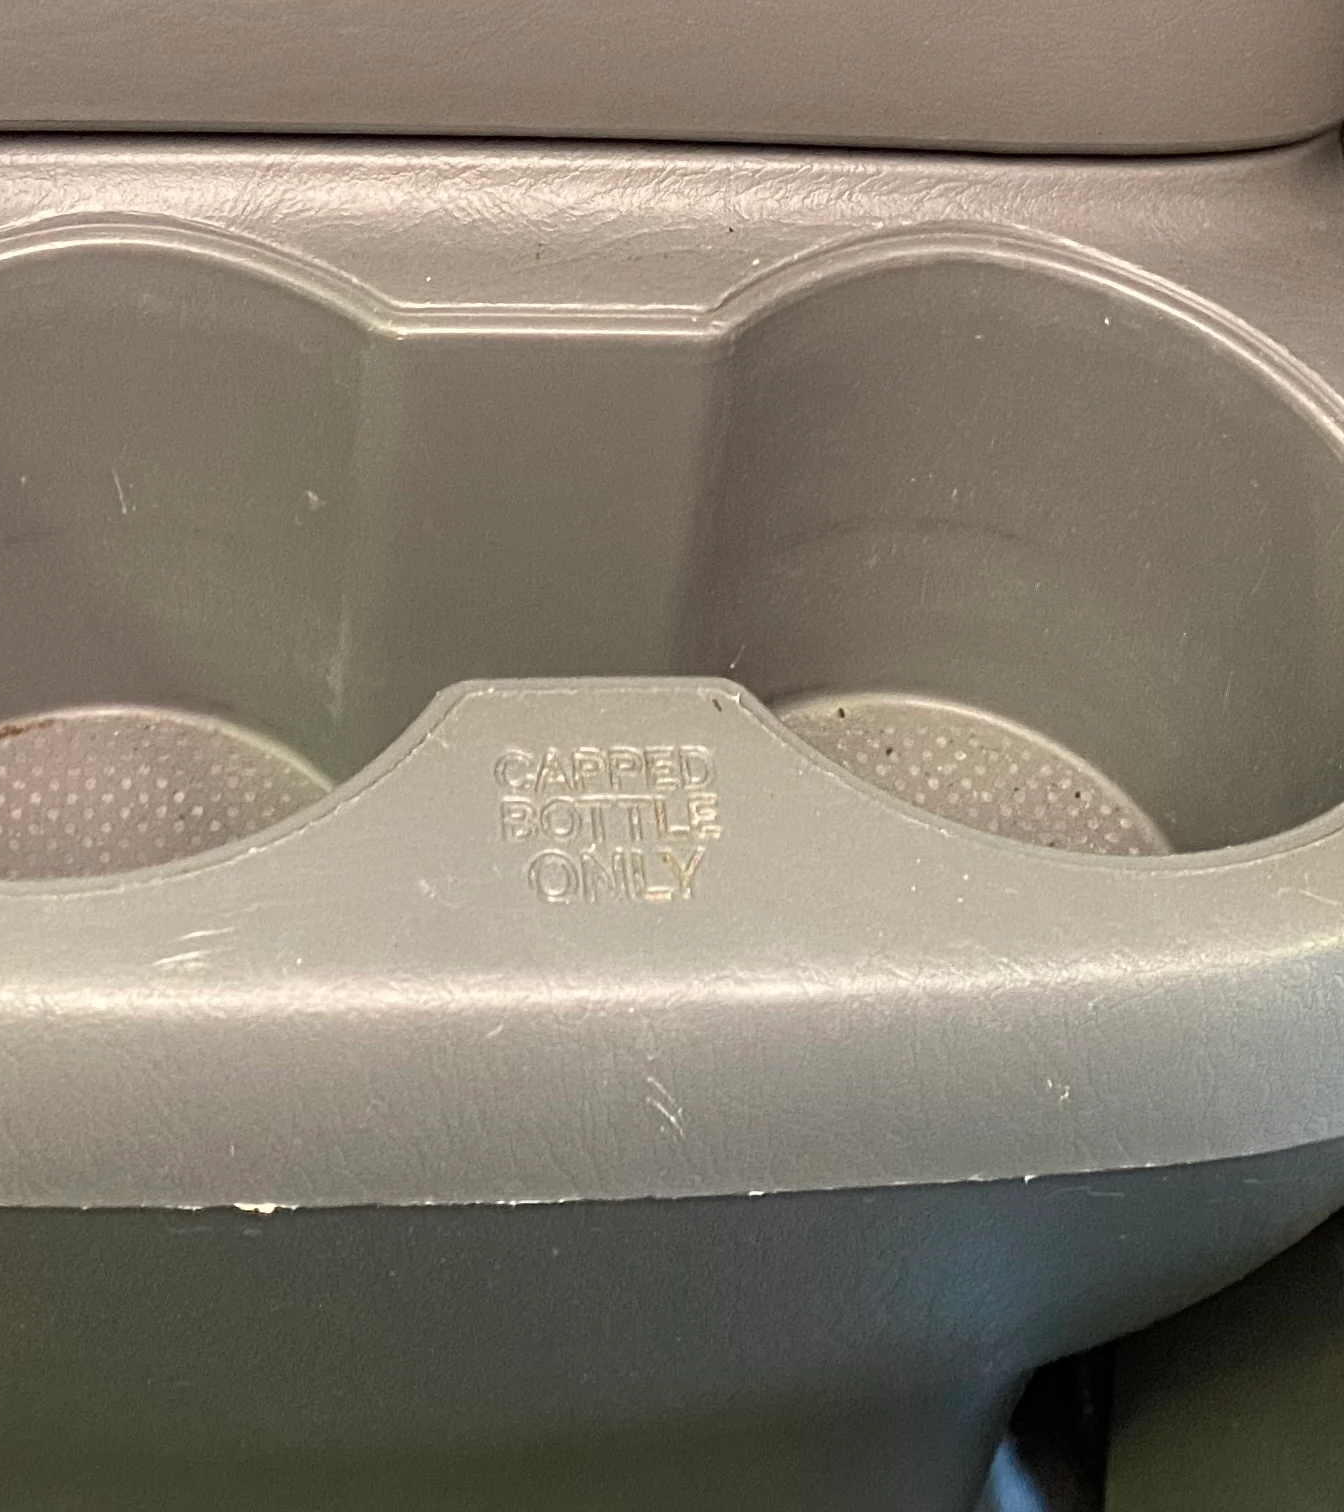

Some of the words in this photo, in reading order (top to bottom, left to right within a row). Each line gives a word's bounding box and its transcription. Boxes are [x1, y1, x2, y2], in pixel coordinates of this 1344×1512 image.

[494, 745, 716, 793] CAPPED
[500, 792, 722, 842] BOTTLE
[527, 844, 705, 904] ONLY
